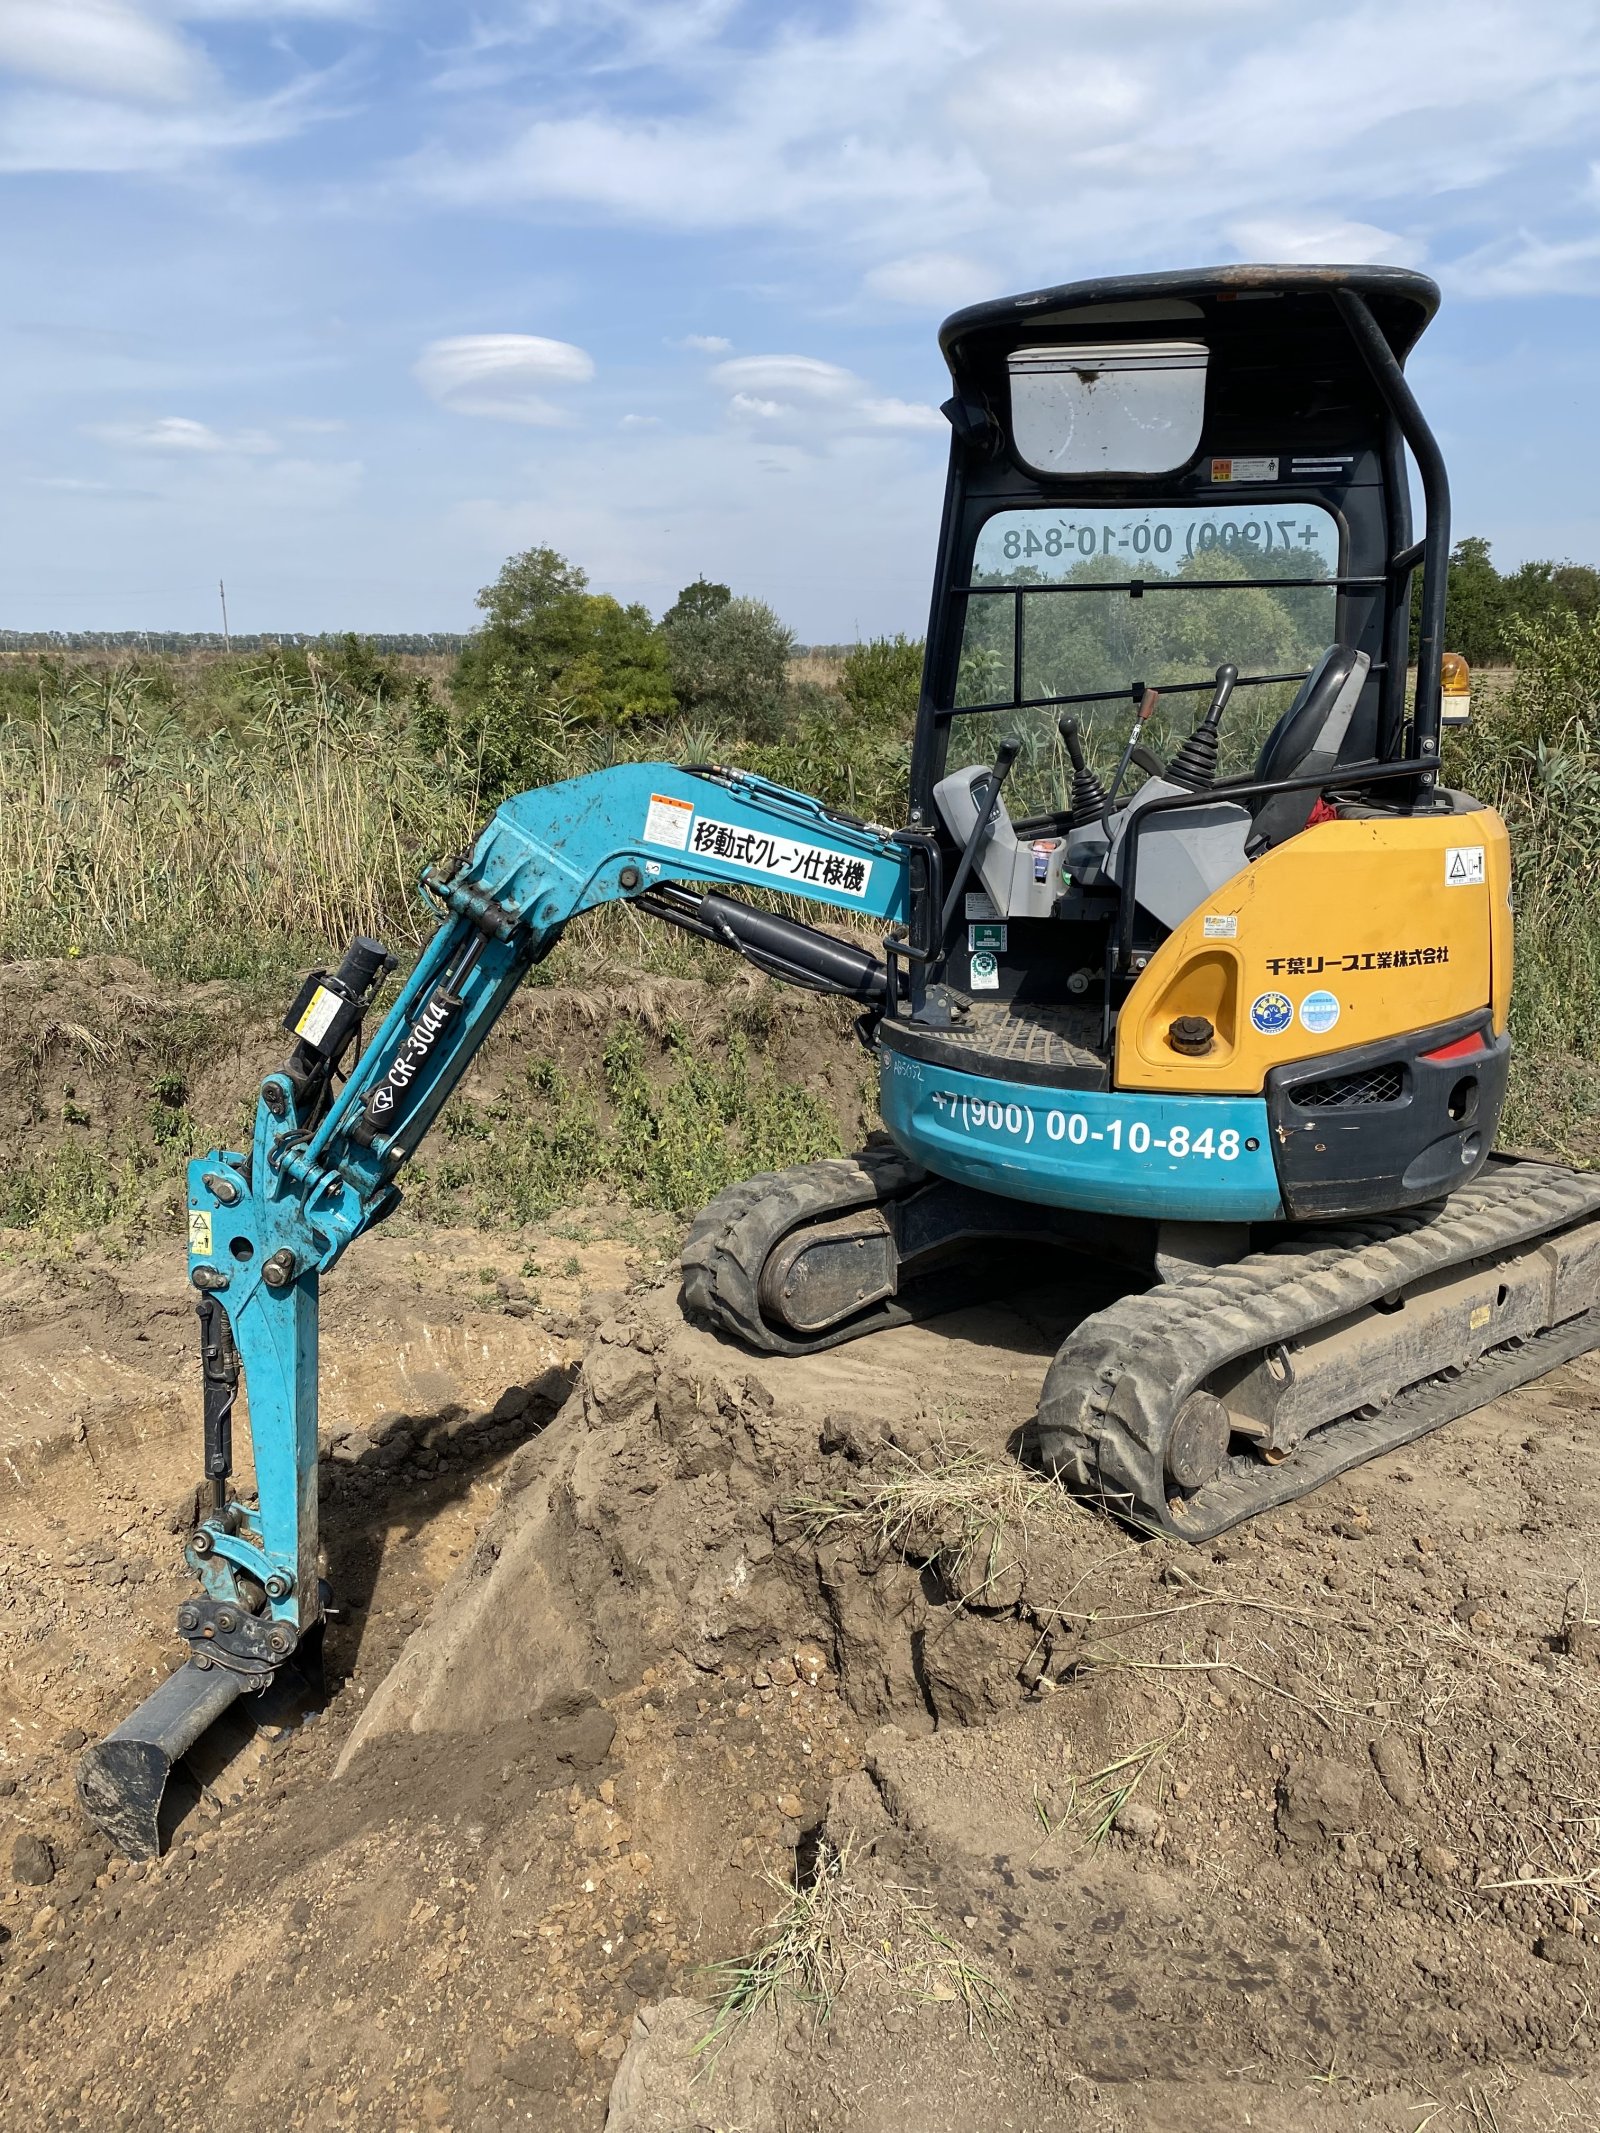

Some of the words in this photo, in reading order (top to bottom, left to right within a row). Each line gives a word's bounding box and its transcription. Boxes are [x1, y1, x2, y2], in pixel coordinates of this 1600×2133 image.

[693, 821, 866, 892] 移動式クレーン仕様機
[1266, 946, 1449, 976] 千葉リース工業株式会社
[388, 1001, 450, 1087] CR-3044
[932, 1090, 1034, 1144] +7(900)
[1046, 1110, 1241, 1161] 00-10-848
